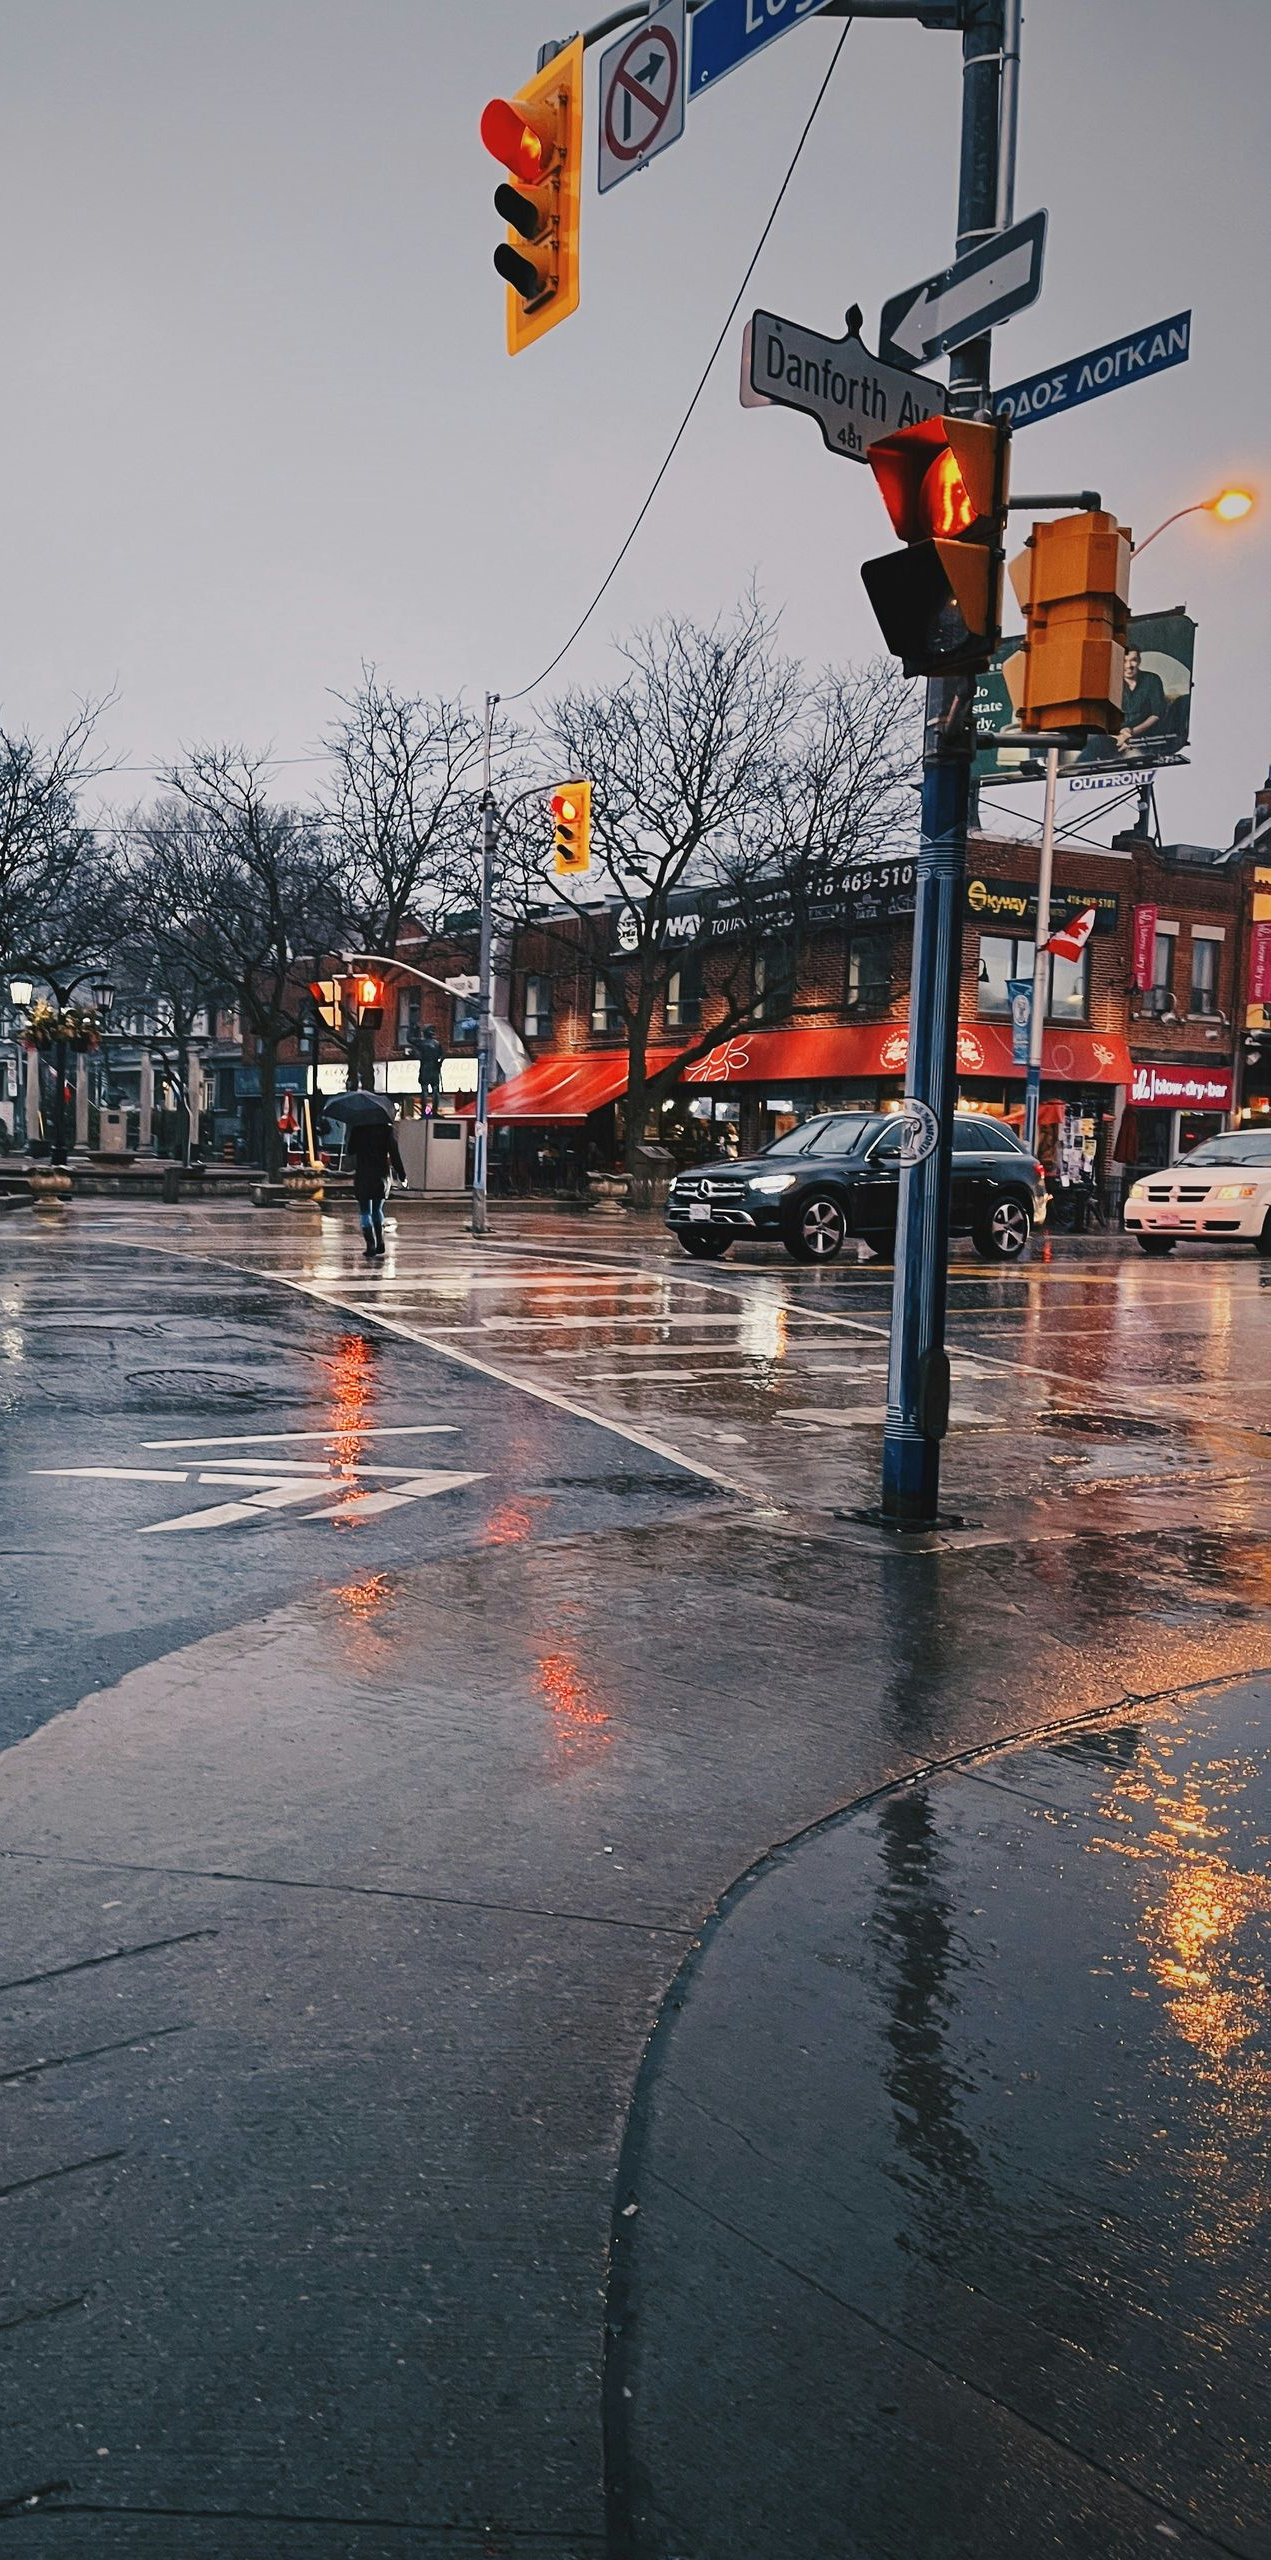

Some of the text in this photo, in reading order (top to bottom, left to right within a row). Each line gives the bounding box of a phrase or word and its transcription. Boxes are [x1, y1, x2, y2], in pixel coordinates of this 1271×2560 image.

[767, 334, 887, 422] Danforth
[837, 427, 862, 451] 481
[1071, 769, 1153, 791] OUTFRONT
